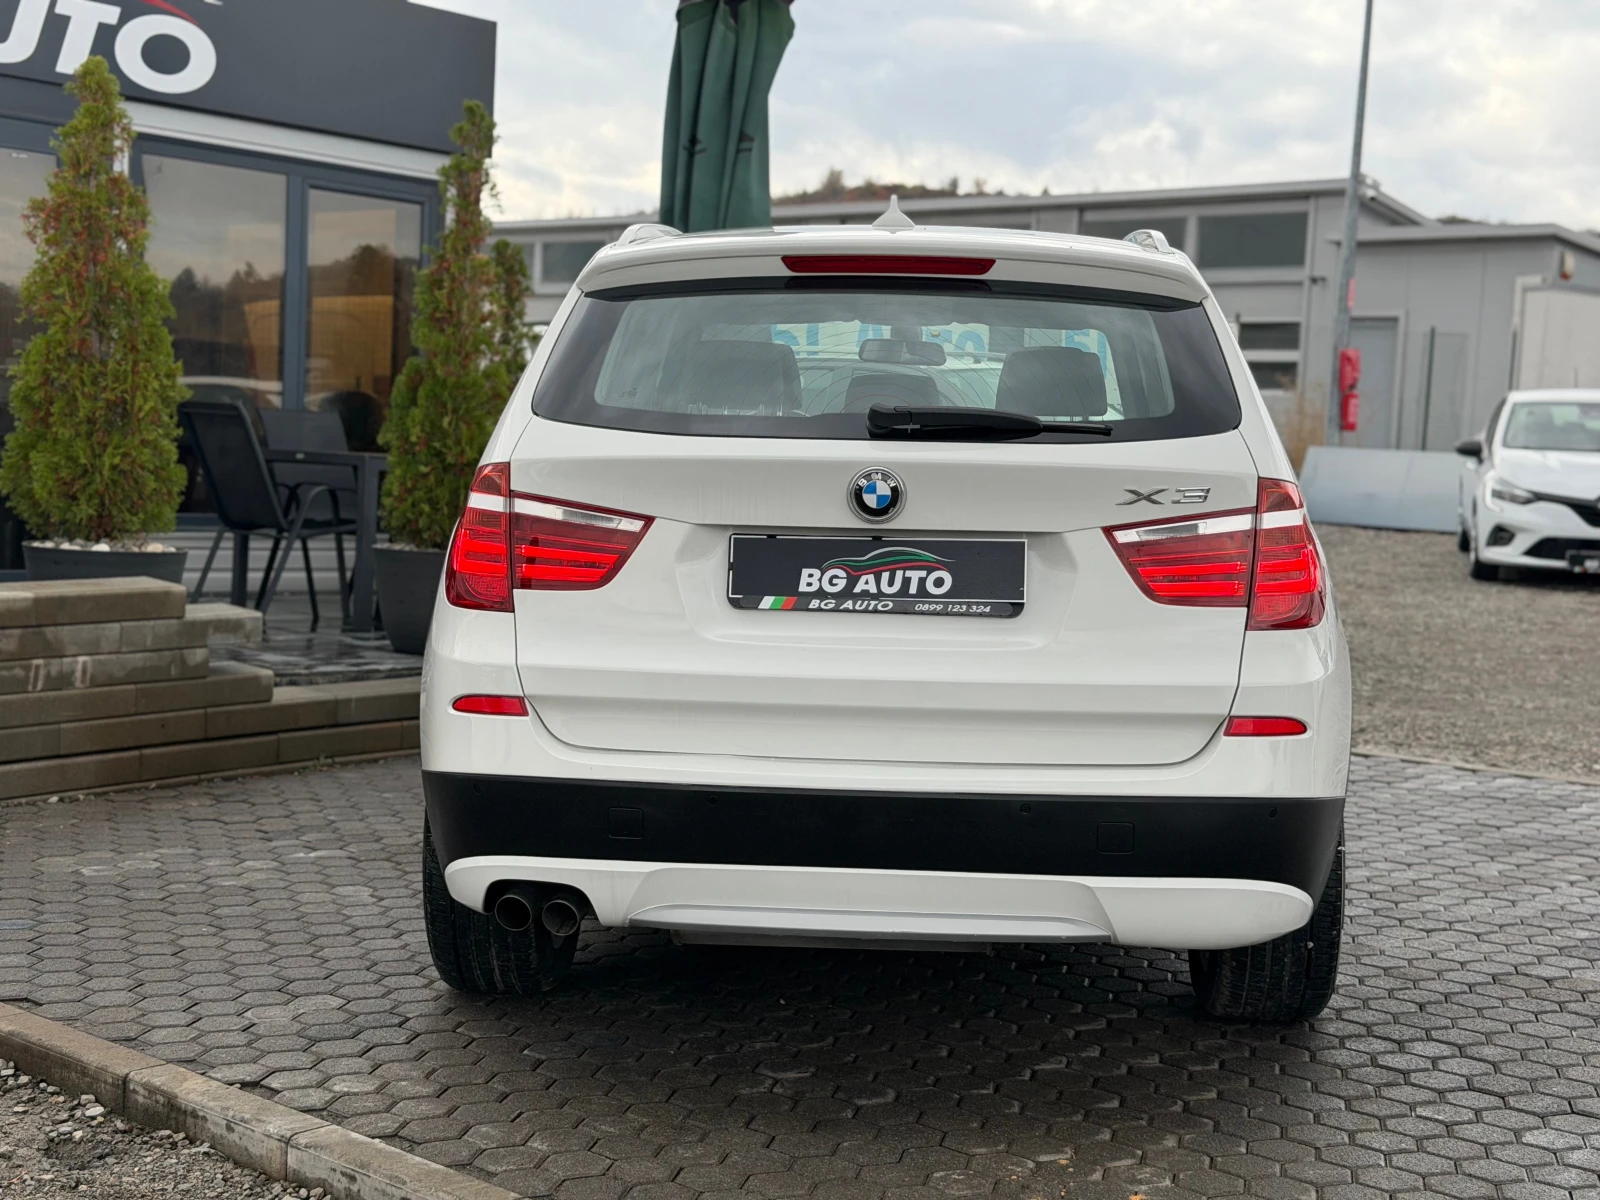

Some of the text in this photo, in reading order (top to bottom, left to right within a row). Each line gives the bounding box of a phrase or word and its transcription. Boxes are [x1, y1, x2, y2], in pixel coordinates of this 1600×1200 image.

[857, 472, 897, 488] BMW
[1114, 486, 1212, 506] X3
[798, 568, 953, 595] BG AUTO
[808, 599, 992, 613] BG AUTO 0899 123 324
